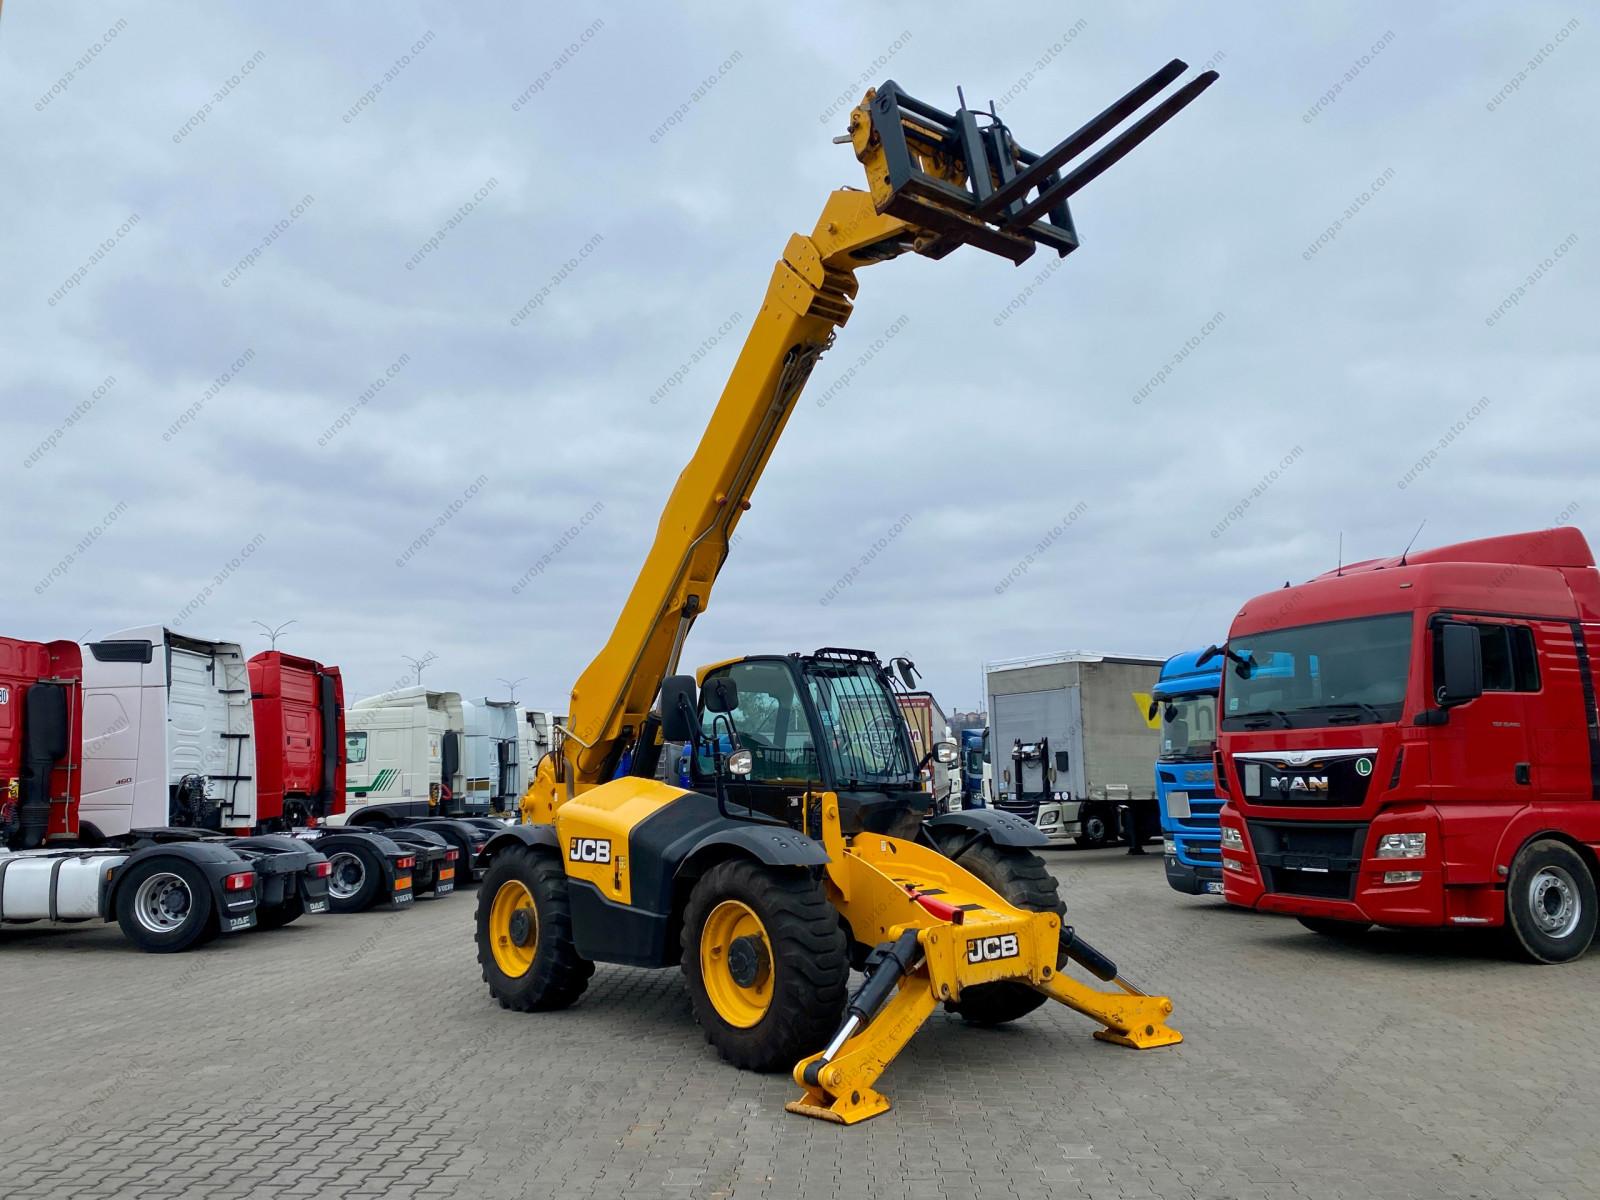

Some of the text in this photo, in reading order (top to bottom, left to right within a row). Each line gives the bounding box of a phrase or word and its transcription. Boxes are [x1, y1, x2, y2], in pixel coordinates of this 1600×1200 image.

[1270, 776, 1329, 792] MAN
[570, 839, 610, 863] JCB
[309, 901, 325, 910] DAF
[229, 916, 250, 926] DAF
[968, 934, 1019, 963] JCB
